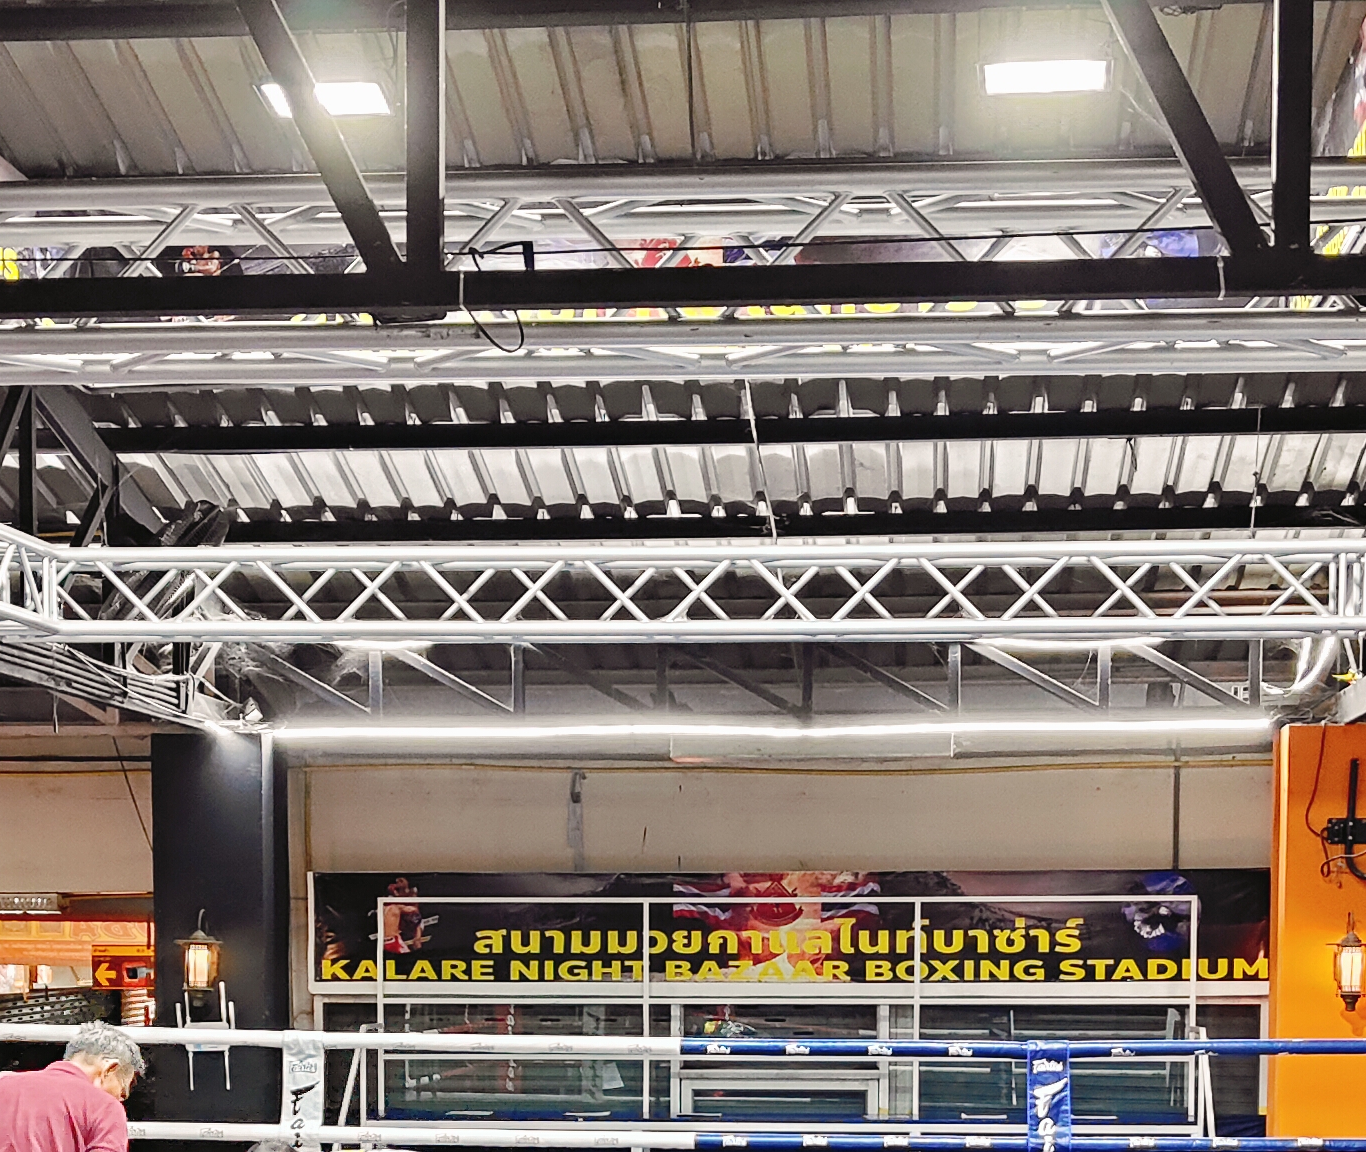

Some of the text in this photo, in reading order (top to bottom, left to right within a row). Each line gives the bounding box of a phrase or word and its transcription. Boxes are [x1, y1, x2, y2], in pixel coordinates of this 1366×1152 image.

[322, 957, 1269, 981] KALARE NIGHT BAZAAR BOXING STADIUM
